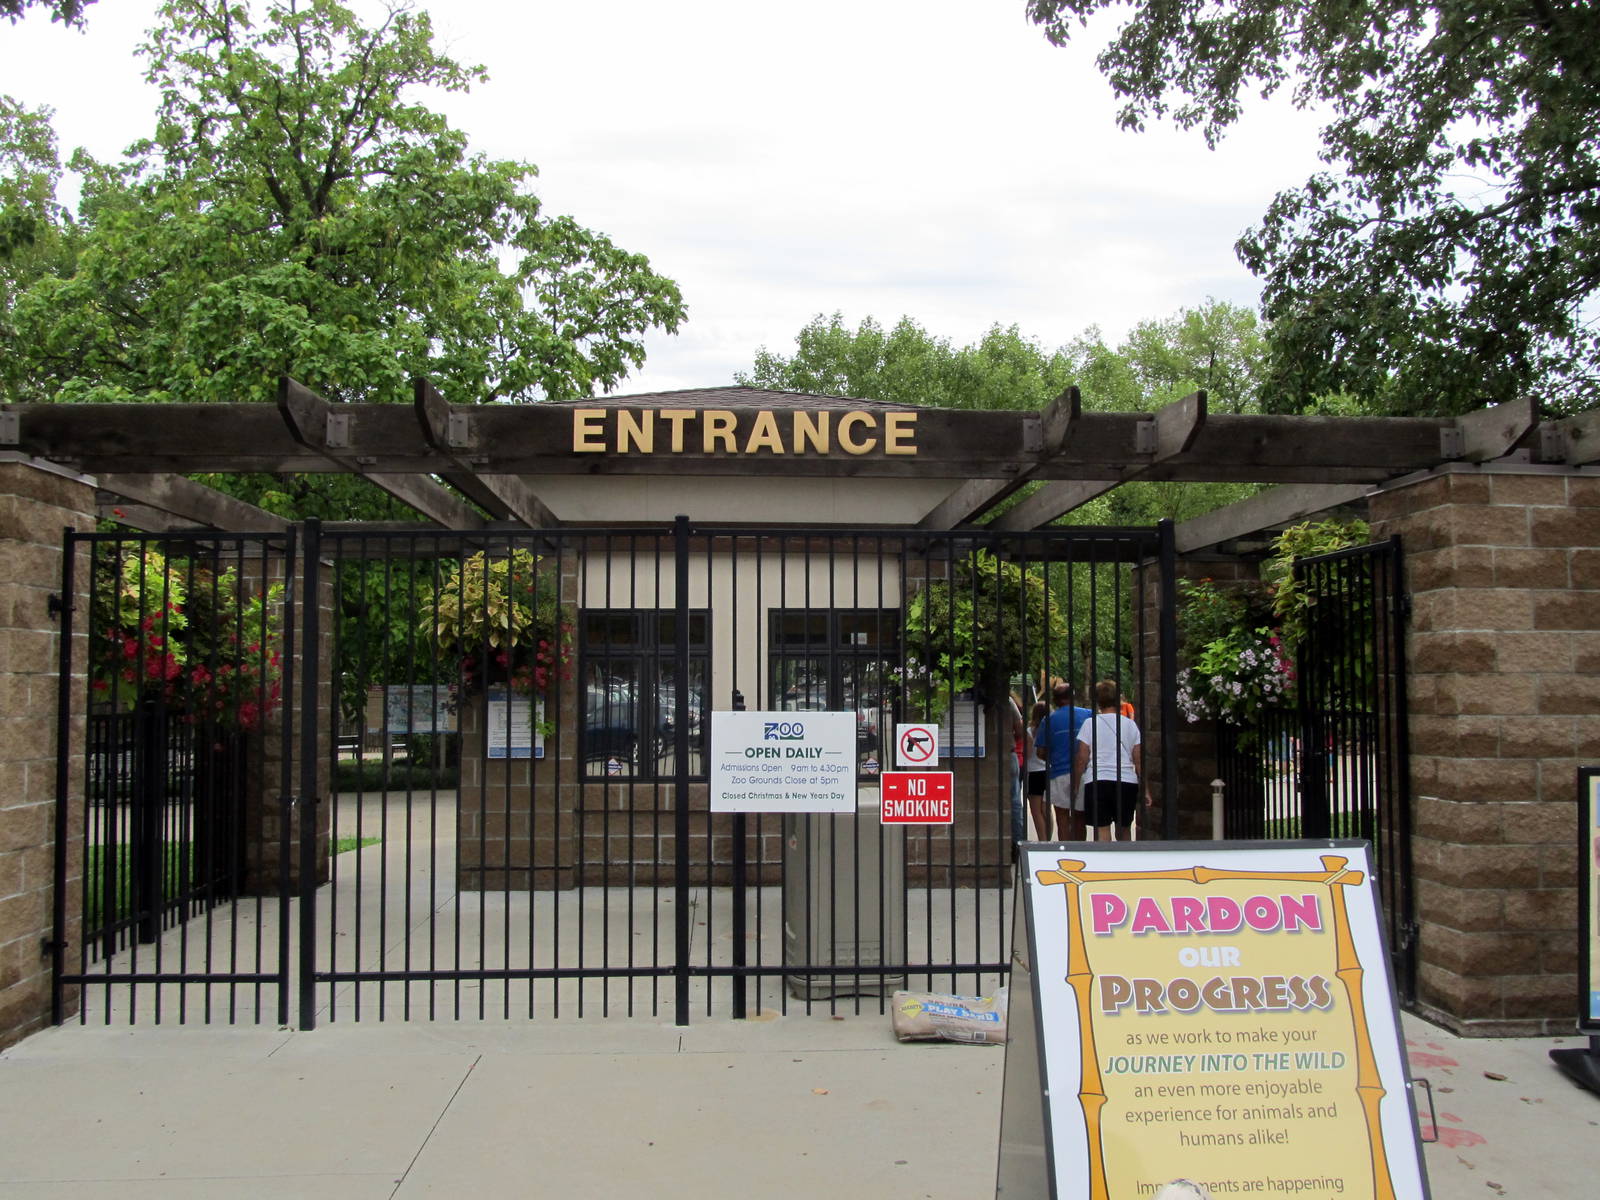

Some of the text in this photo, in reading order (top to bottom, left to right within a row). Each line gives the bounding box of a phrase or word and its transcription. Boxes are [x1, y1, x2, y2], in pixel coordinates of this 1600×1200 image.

[573, 408, 918, 455] ENTRANCE
[764, 722, 804, 740] ZOO
[744, 747, 823, 759] OPEN DAILY
[720, 763, 760, 772] Admissions
[761, 764, 783, 773] Open
[790, 764, 809, 772] 9am
[810, 764, 818, 772] to
[731, 776, 839, 786] Zoo Grounds Close at 5pm
[907, 778, 927, 796] NO
[721, 792, 746, 800] Closed
[747, 792, 783, 800] Christmas
[791, 792, 807, 800] New
[809, 792, 829, 800] Years
[830, 792, 845, 801] Day
[884, 799, 950, 818] SMOKING
[1090, 893, 1323, 935] PARDON
[1178, 946, 1241, 968] OUR
[1098, 975, 1333, 1014] PROGRESS
[1126, 1027, 1318, 1046] as we work to make your
[1104, 1052, 1347, 1075] JOURNEY INTO THE WILD
[1134, 1078, 1323, 1100] an even more enjoyable
[1125, 1102, 1338, 1126] experience for animals and
[1179, 1128, 1290, 1148] humans alike!
[1136, 1175, 1344, 1197] Imments are happening
